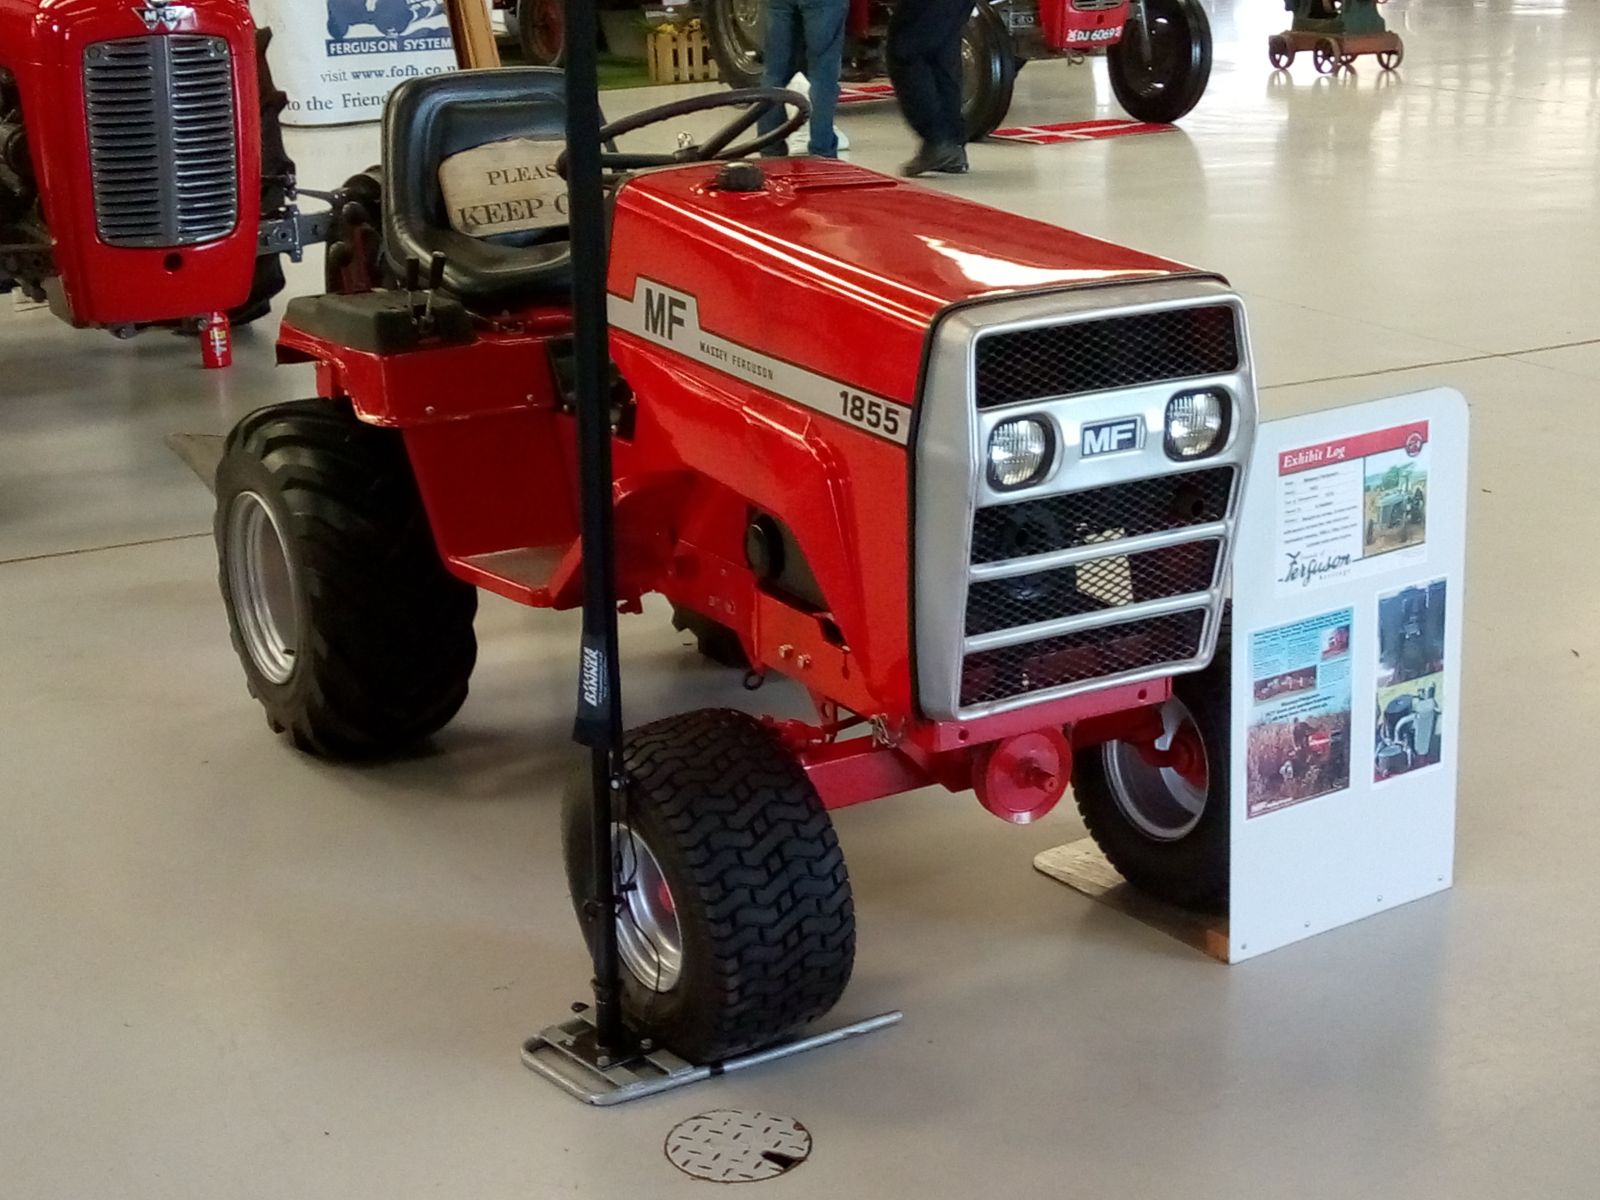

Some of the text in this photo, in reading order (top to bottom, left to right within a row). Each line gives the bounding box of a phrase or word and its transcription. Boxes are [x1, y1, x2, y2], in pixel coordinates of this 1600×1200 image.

[330, 37, 452, 54] FERGUSON SYSTEM
[320, 70, 347, 82] visit
[306, 96, 333, 111] the
[458, 198, 543, 226] KEEP
[644, 287, 687, 341] MF
[700, 342, 774, 380] MASSEY FERGUSON
[839, 390, 900, 435] 1855
[1083, 422, 1136, 454] MF
[1283, 446, 1346, 468] Exhibit Log
